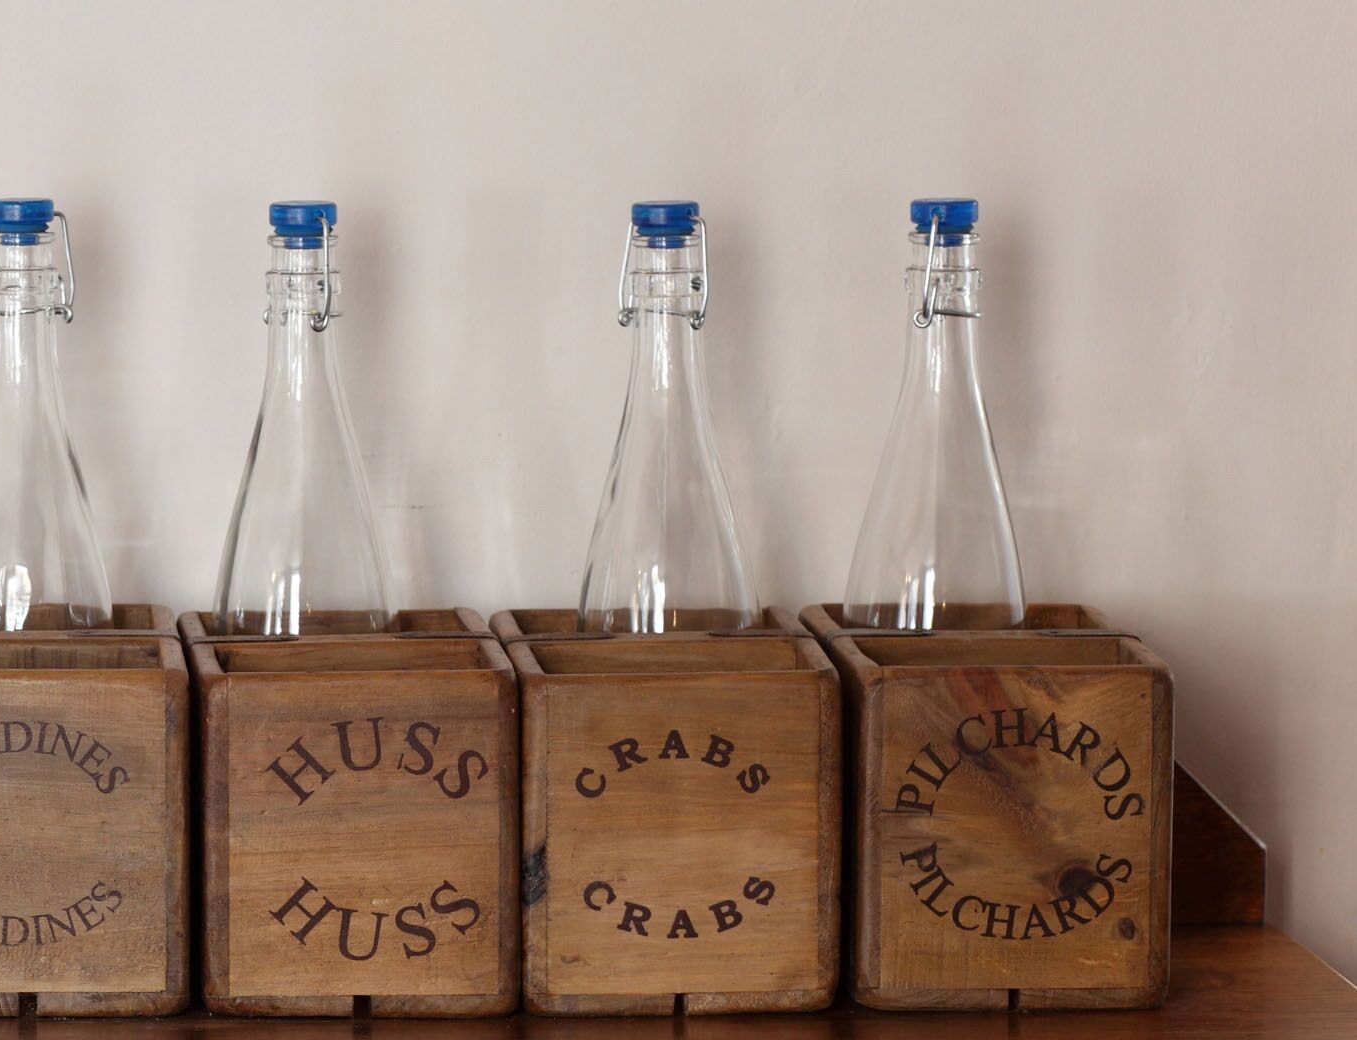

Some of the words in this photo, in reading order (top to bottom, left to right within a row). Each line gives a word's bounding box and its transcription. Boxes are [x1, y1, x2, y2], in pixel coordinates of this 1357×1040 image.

[265, 716, 490, 806] HUSS
[574, 728, 772, 799] CRABS
[896, 707, 1144, 820] PILCHARDS
[268, 876, 481, 962] HUSS
[582, 875, 776, 940] CRABS
[899, 841, 1133, 940] PILCHARDS
